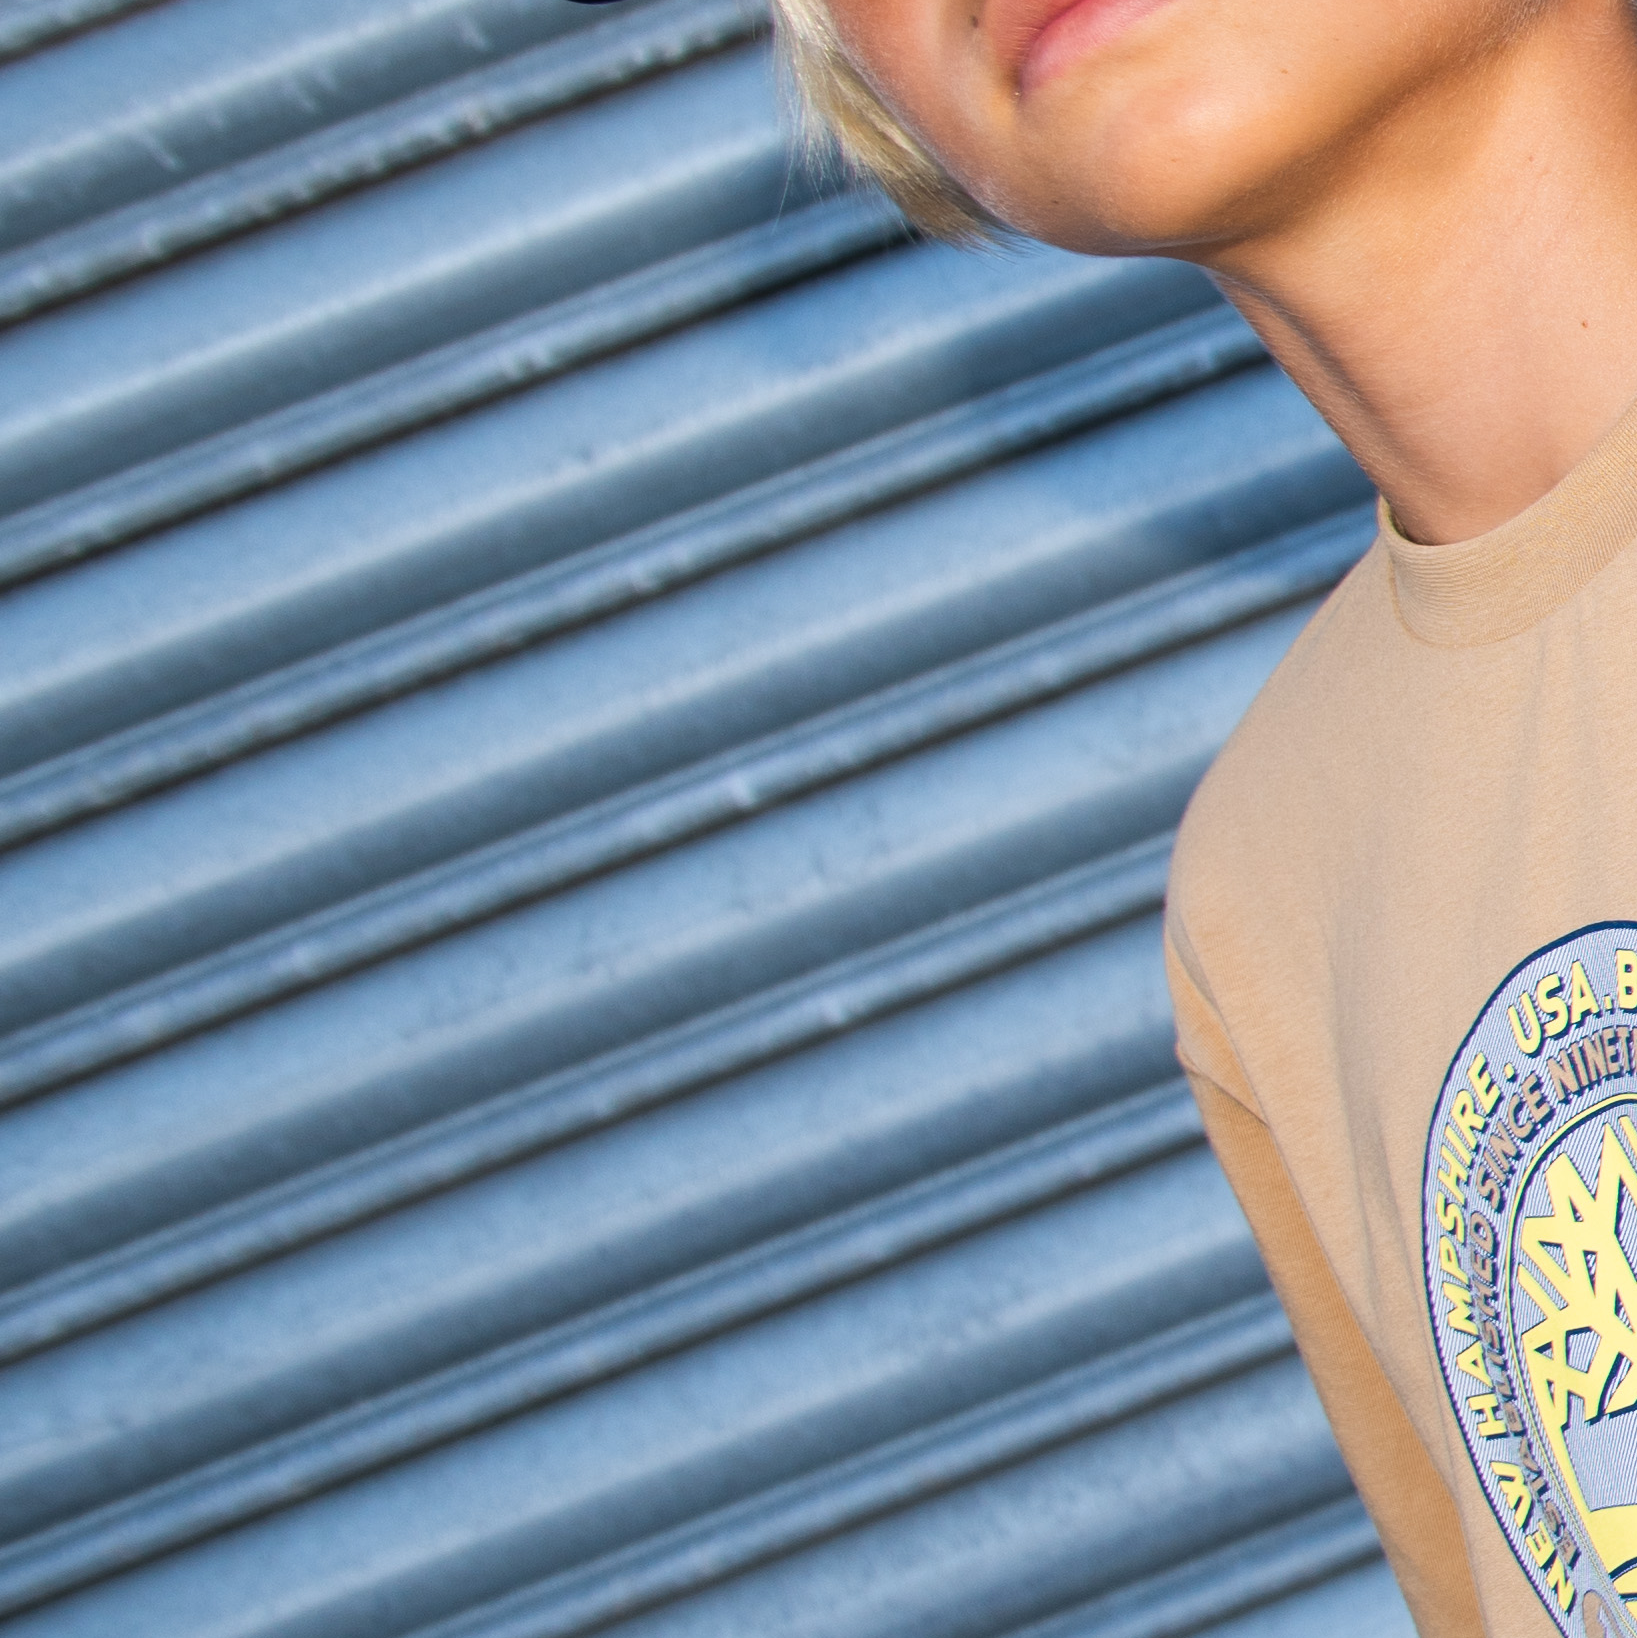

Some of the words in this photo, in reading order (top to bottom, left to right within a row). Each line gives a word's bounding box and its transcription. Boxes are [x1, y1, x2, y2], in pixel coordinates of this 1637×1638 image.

[1476, 1074, 1553, 1211] SINCE
[1469, 1211, 1580, 1567] ESTABLISHED
[1489, 1459, 1576, 1615] NEW
